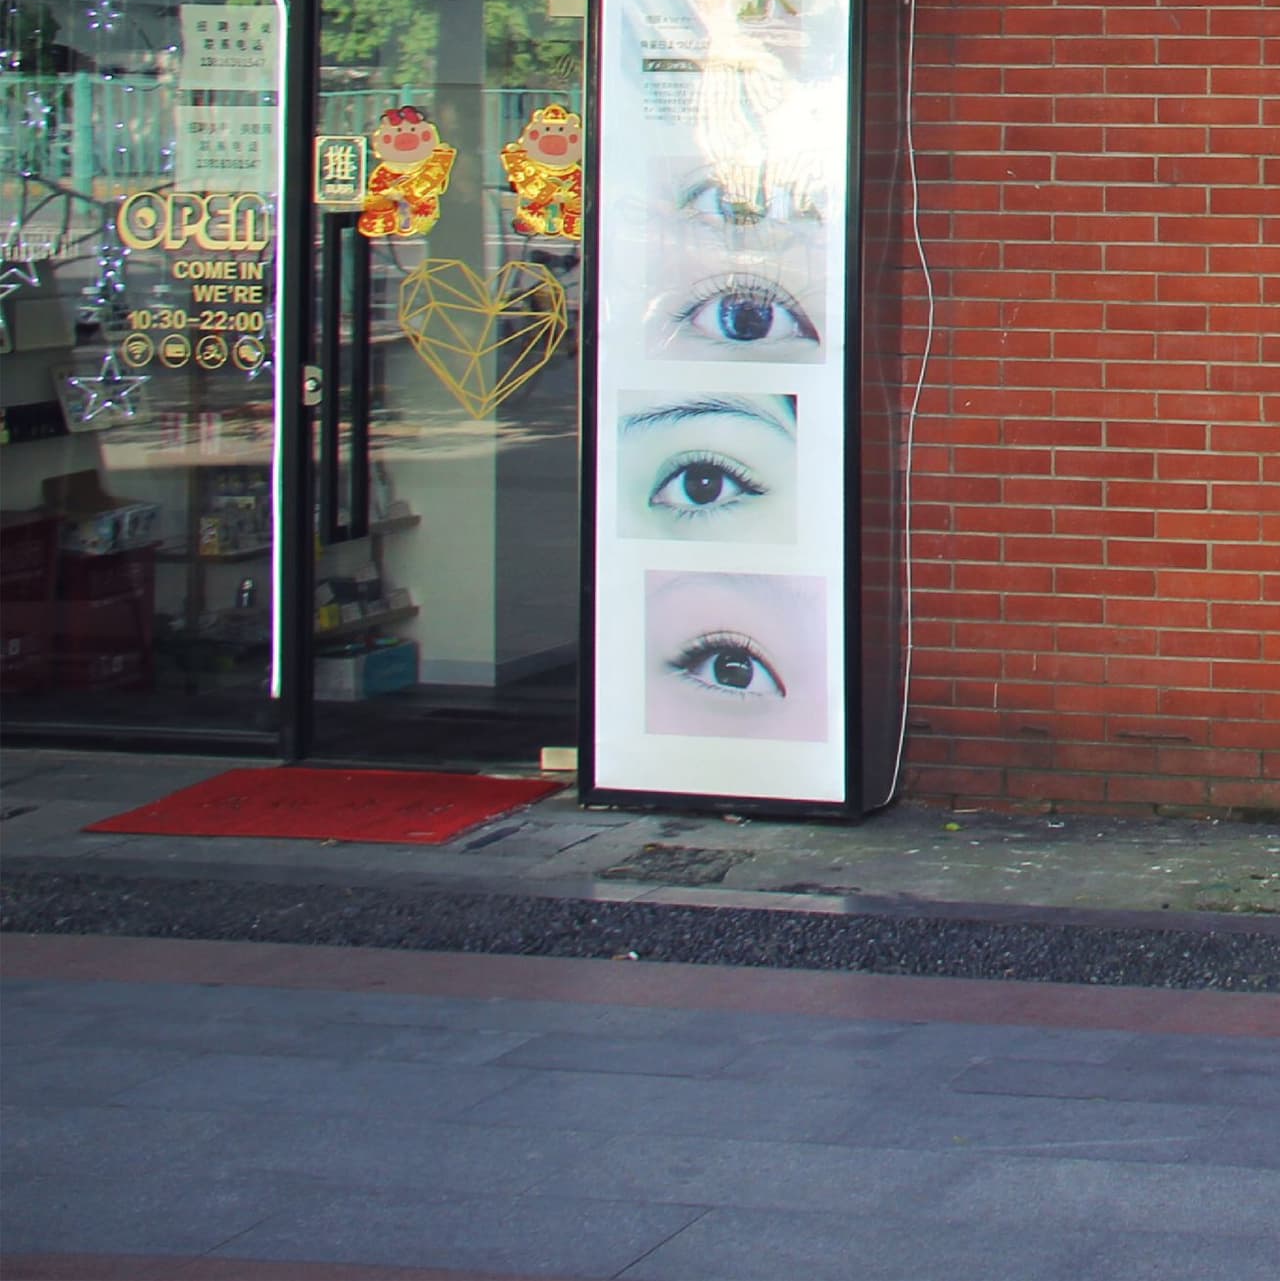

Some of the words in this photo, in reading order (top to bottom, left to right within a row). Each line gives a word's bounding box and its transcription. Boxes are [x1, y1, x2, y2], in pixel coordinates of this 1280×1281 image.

[172, 260, 237, 281] COME
[240, 260, 264, 281] IN
[192, 284, 264, 304] WE'RE
